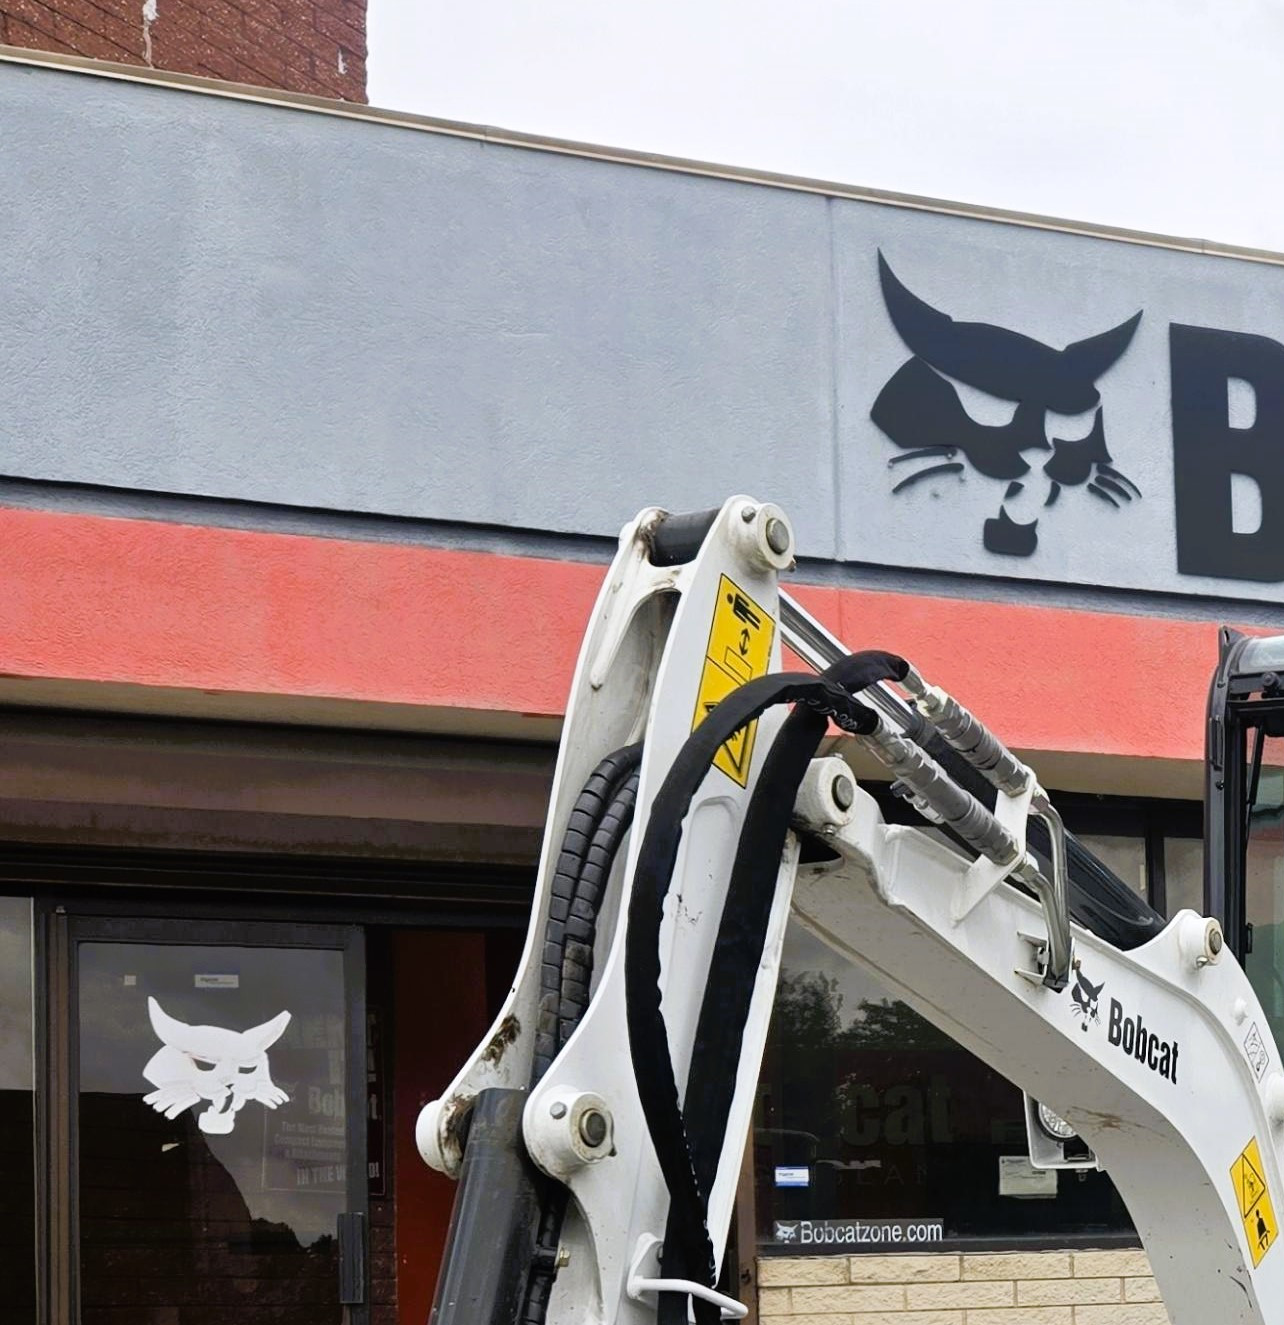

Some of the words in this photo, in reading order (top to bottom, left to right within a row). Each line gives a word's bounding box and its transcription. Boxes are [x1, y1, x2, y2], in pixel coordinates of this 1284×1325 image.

[1108, 997, 1179, 1085] Bobcat
[308, 1086, 379, 1121] Bobt
[311, 1167, 335, 1185] THE
[801, 1221, 943, 1244] Bobcatzone.com
